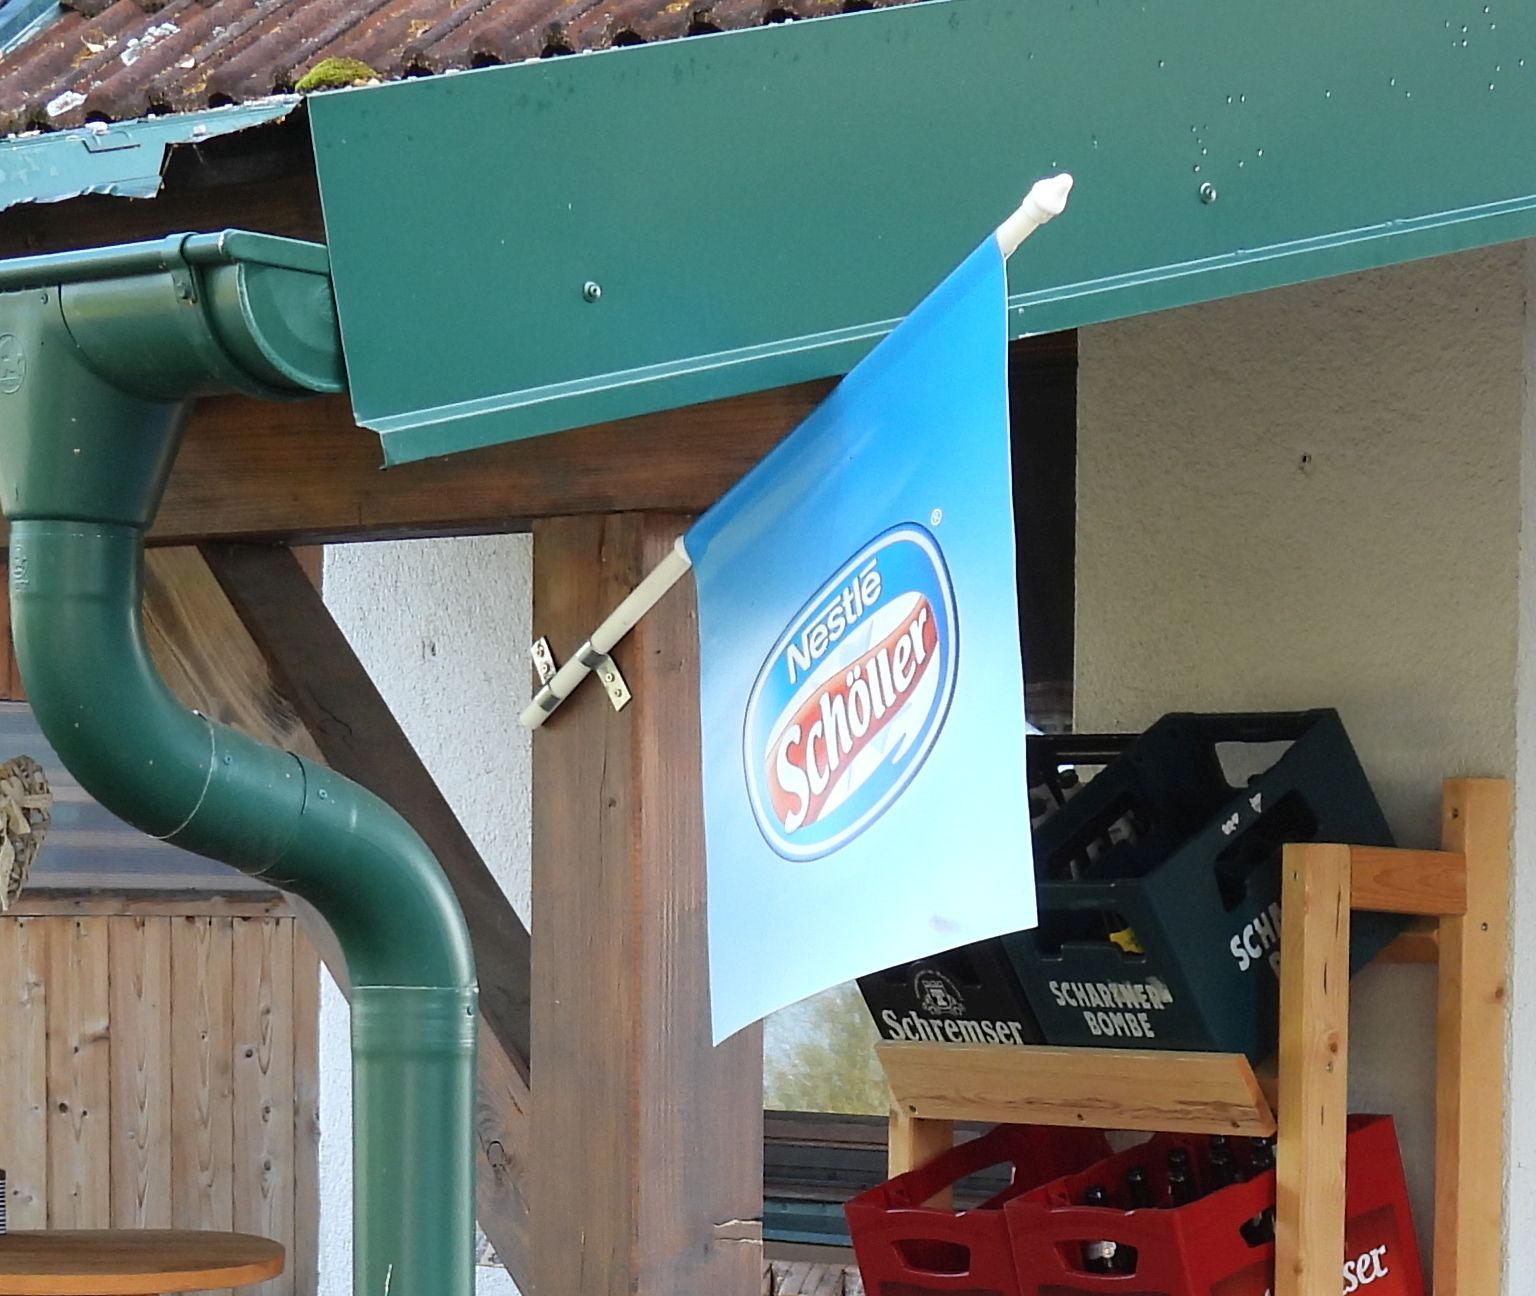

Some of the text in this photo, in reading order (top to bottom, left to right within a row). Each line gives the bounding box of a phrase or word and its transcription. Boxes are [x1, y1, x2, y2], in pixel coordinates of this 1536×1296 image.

[787, 558, 882, 685] Nestlé
[777, 607, 928, 834] Schöller
[882, 1009, 1024, 1045] Schremser
[1083, 1011, 1154, 1037] BOMBE
